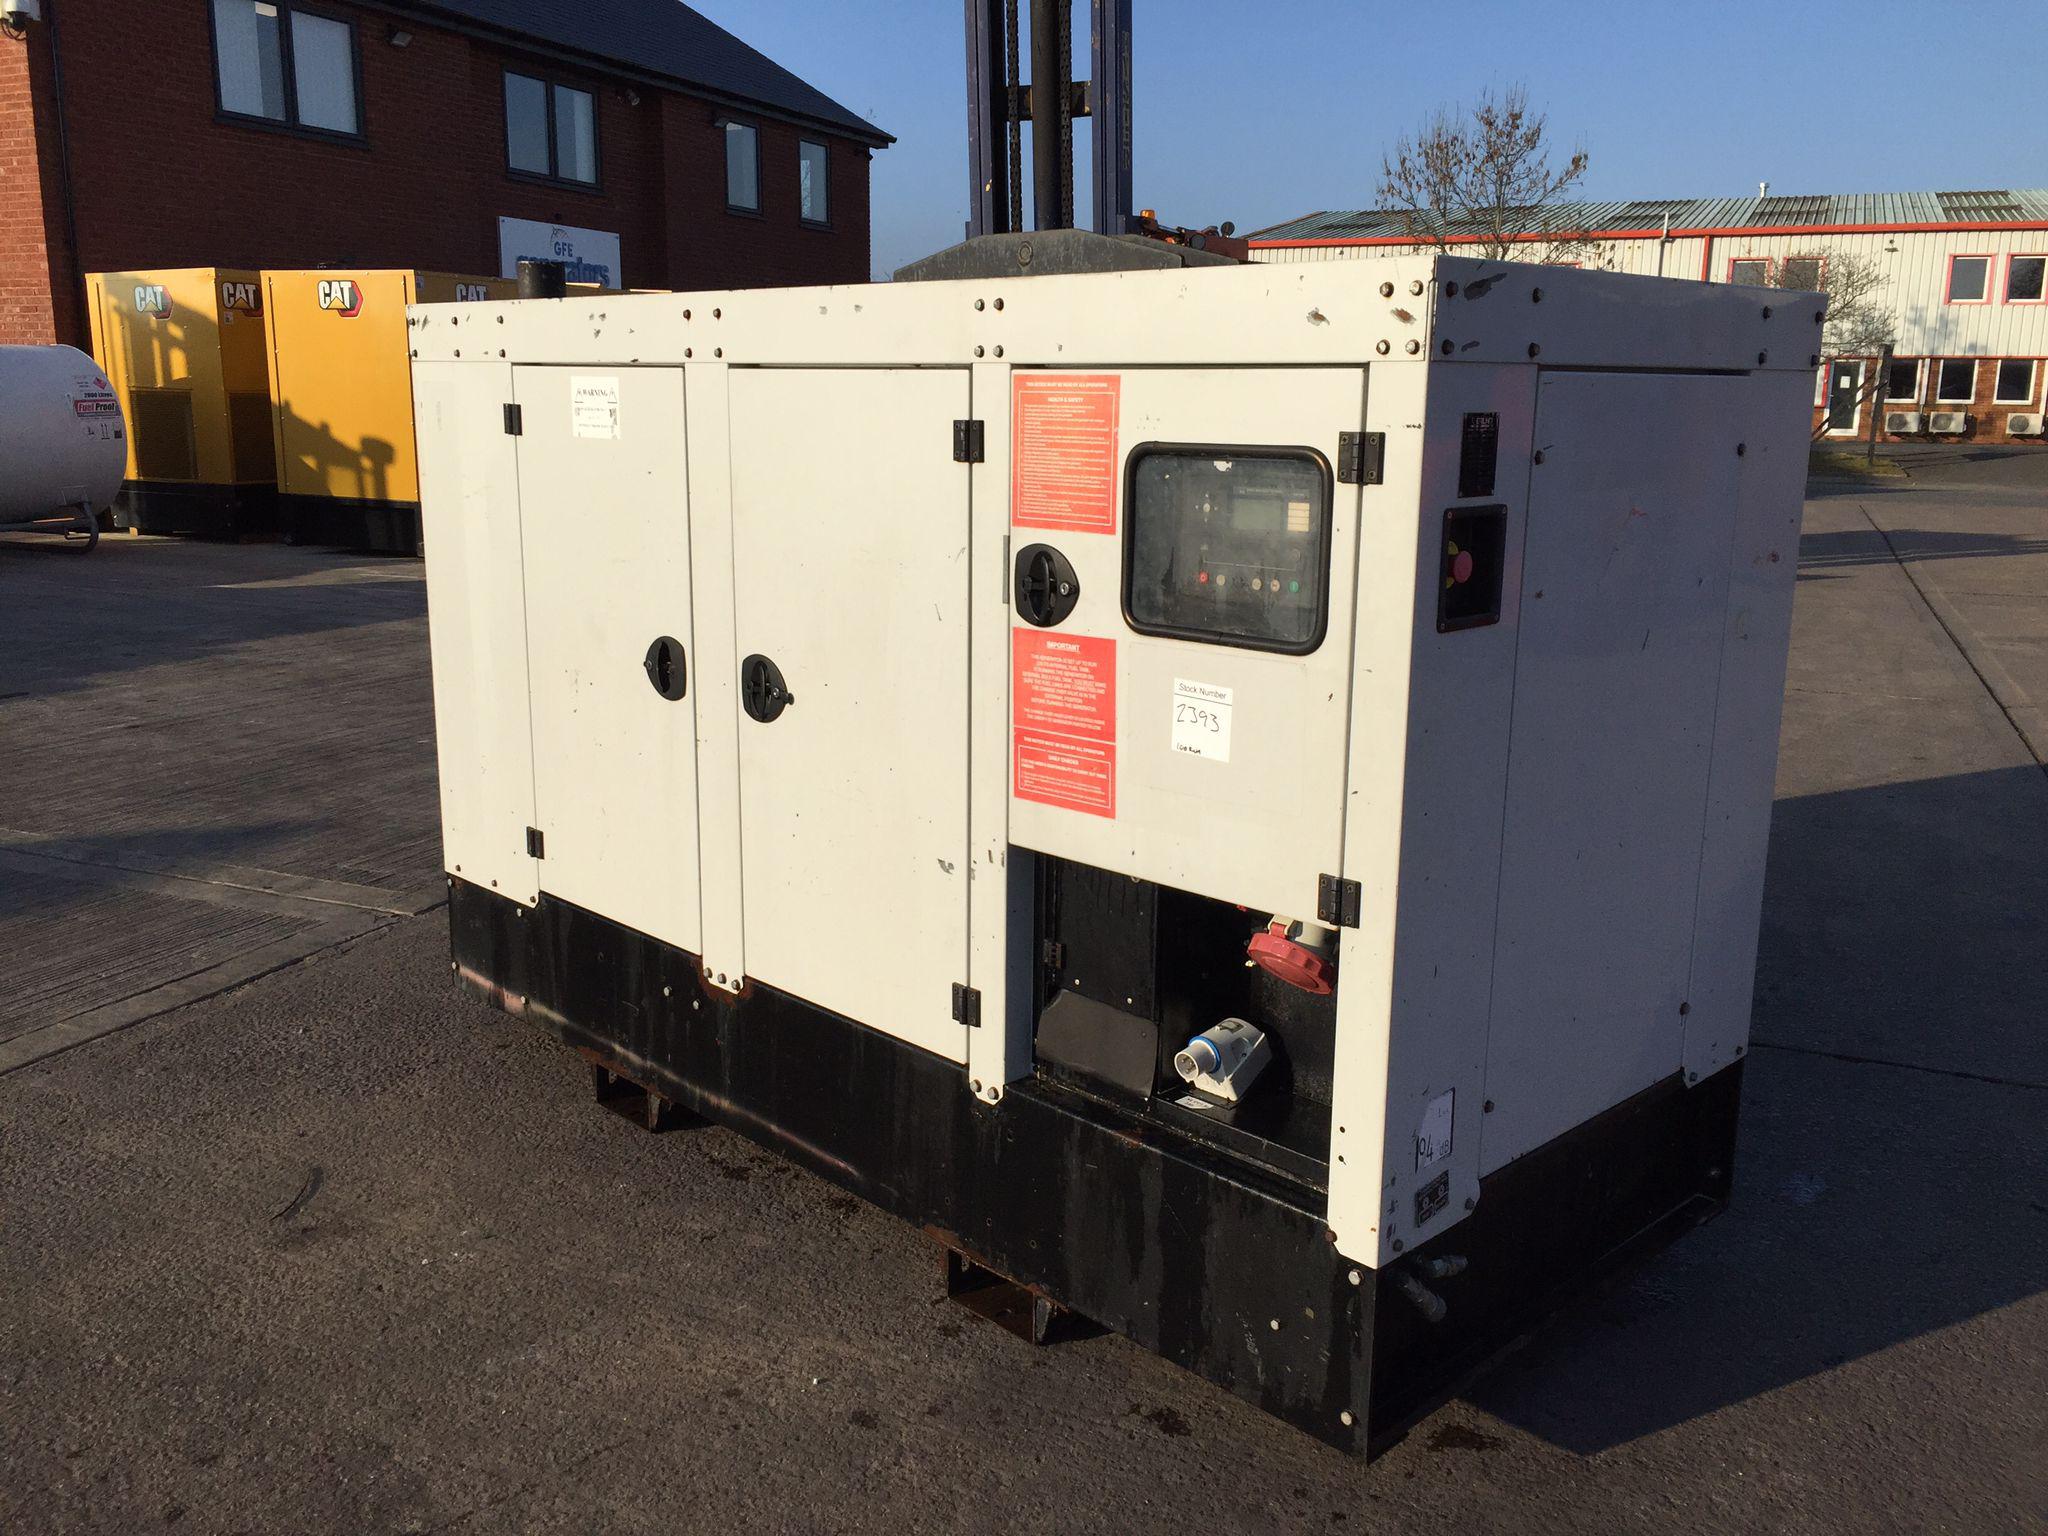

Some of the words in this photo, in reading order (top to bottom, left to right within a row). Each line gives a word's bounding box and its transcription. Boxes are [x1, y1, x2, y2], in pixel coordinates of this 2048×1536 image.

[554, 241, 574, 257] GFE
[134, 286, 164, 312] CAT
[222, 282, 257, 309] CAT
[318, 281, 352, 309] CAT
[455, 284, 488, 302] CAT
[582, 389, 608, 397] WARNING
[79, 403, 95, 412] Fuel
[95, 403, 115, 411] Proof
[1046, 640, 1081, 652] IMPORTANT
[1179, 683, 1197, 692] Stock
[1199, 688, 1226, 699] Number
[1177, 703, 1220, 732] 2393
[1415, 1133, 1434, 1173] 104
[1439, 1139, 1449, 1156] dB
